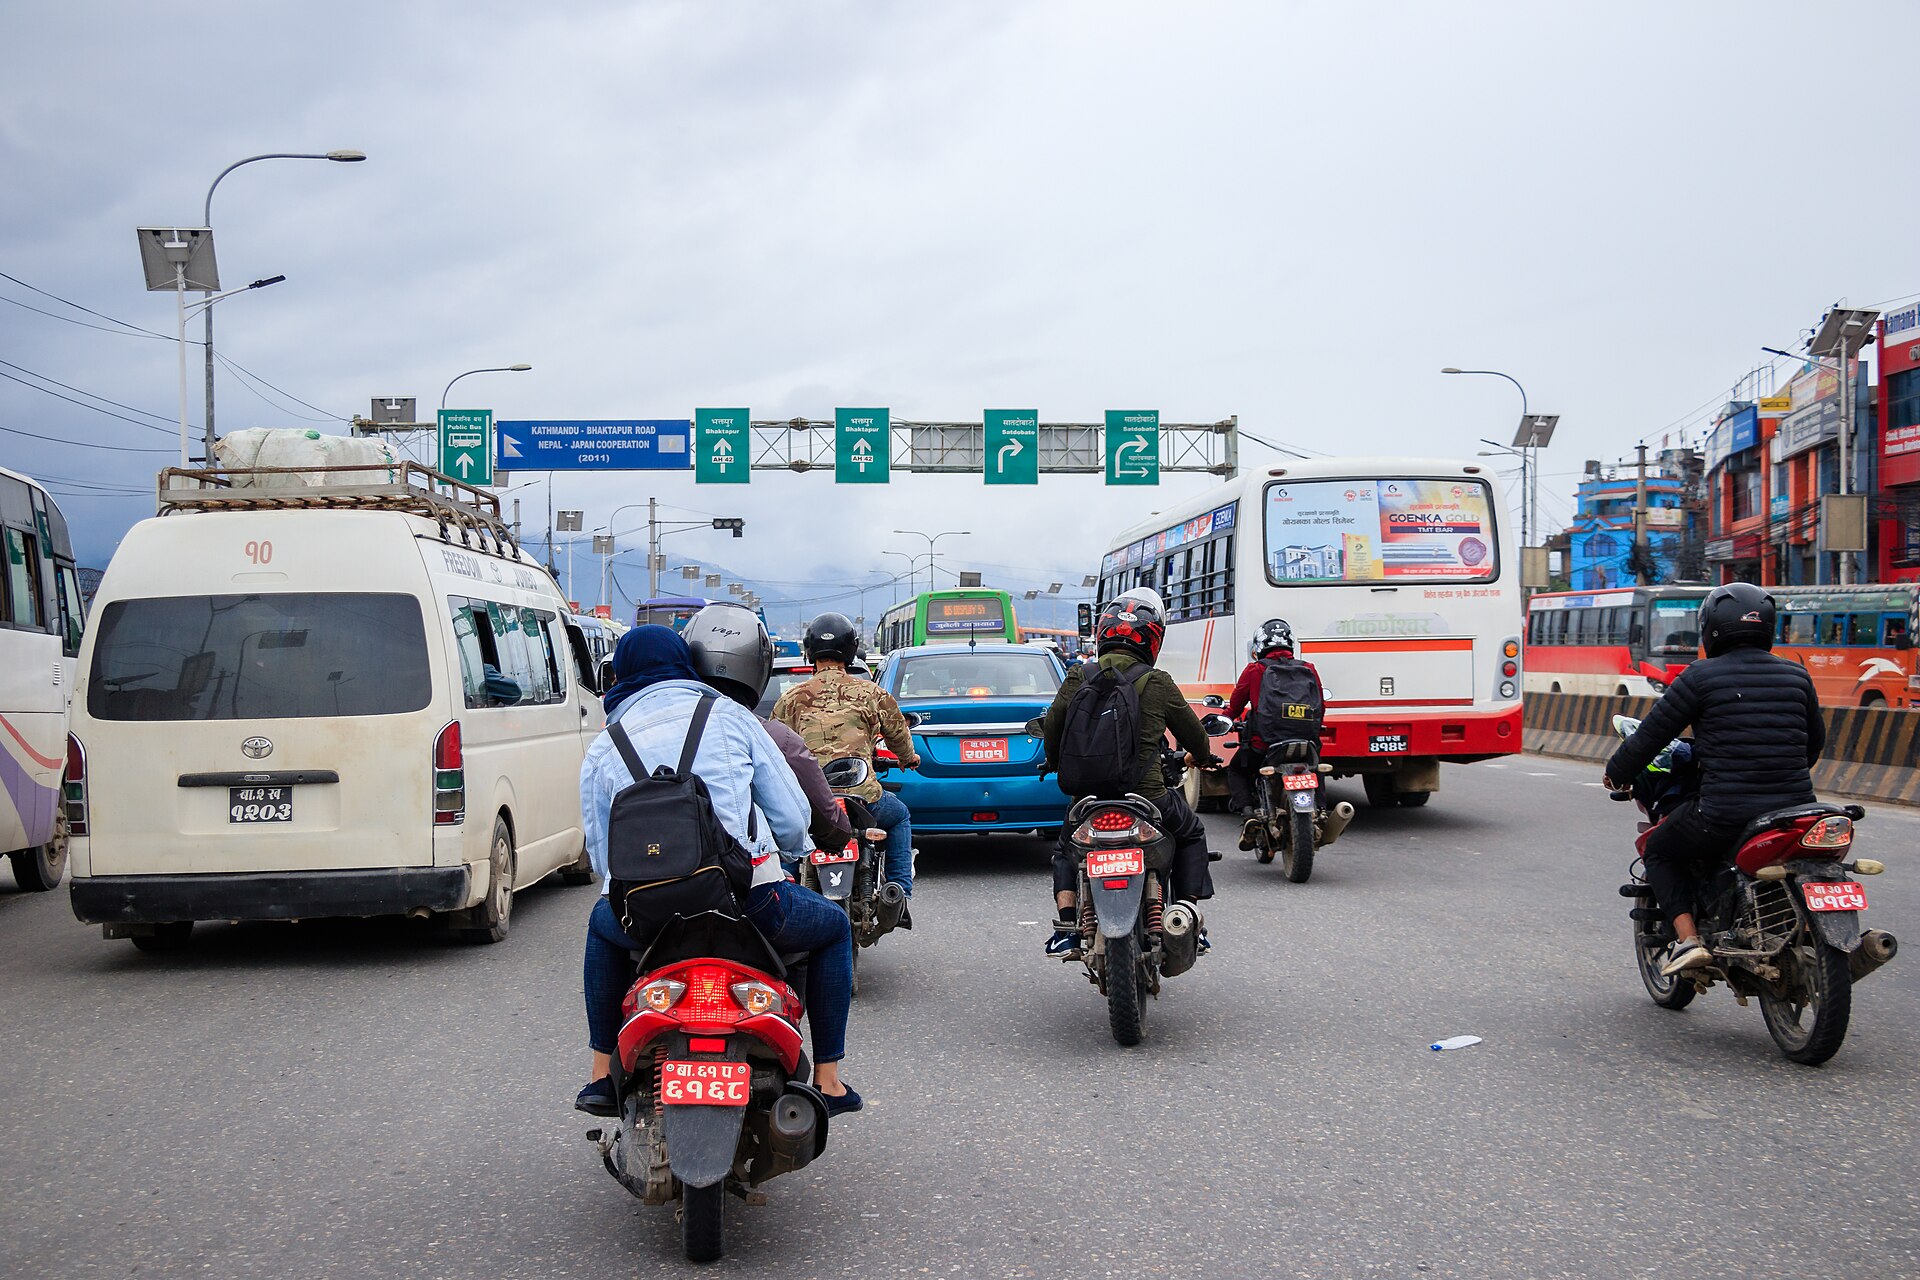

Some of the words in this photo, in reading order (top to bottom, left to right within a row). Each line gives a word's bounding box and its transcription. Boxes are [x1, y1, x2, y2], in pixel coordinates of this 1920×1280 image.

[1884, 309, 1916, 336] Kamana
[531, 426, 579, 435] KATHMANDU
[586, 426, 633, 435] BHAKTAPUR
[635, 426, 656, 435] ROAD
[538, 440, 563, 449] NEPAL
[570, 440, 595, 449] JAPAN
[596, 440, 650, 449] COOPERATION
[578, 454, 610, 464] (2011)
[1389, 514, 1443, 523] GOENKA
[1445, 514, 1480, 522] GOLD
[441, 549, 483, 579] FREEDOM
[1287, 705, 1307, 718] CAT
[231, 803, 292, 822] १२०३
[721, 1066, 733, 1079] प
[666, 1080, 745, 1100] ६१६८
